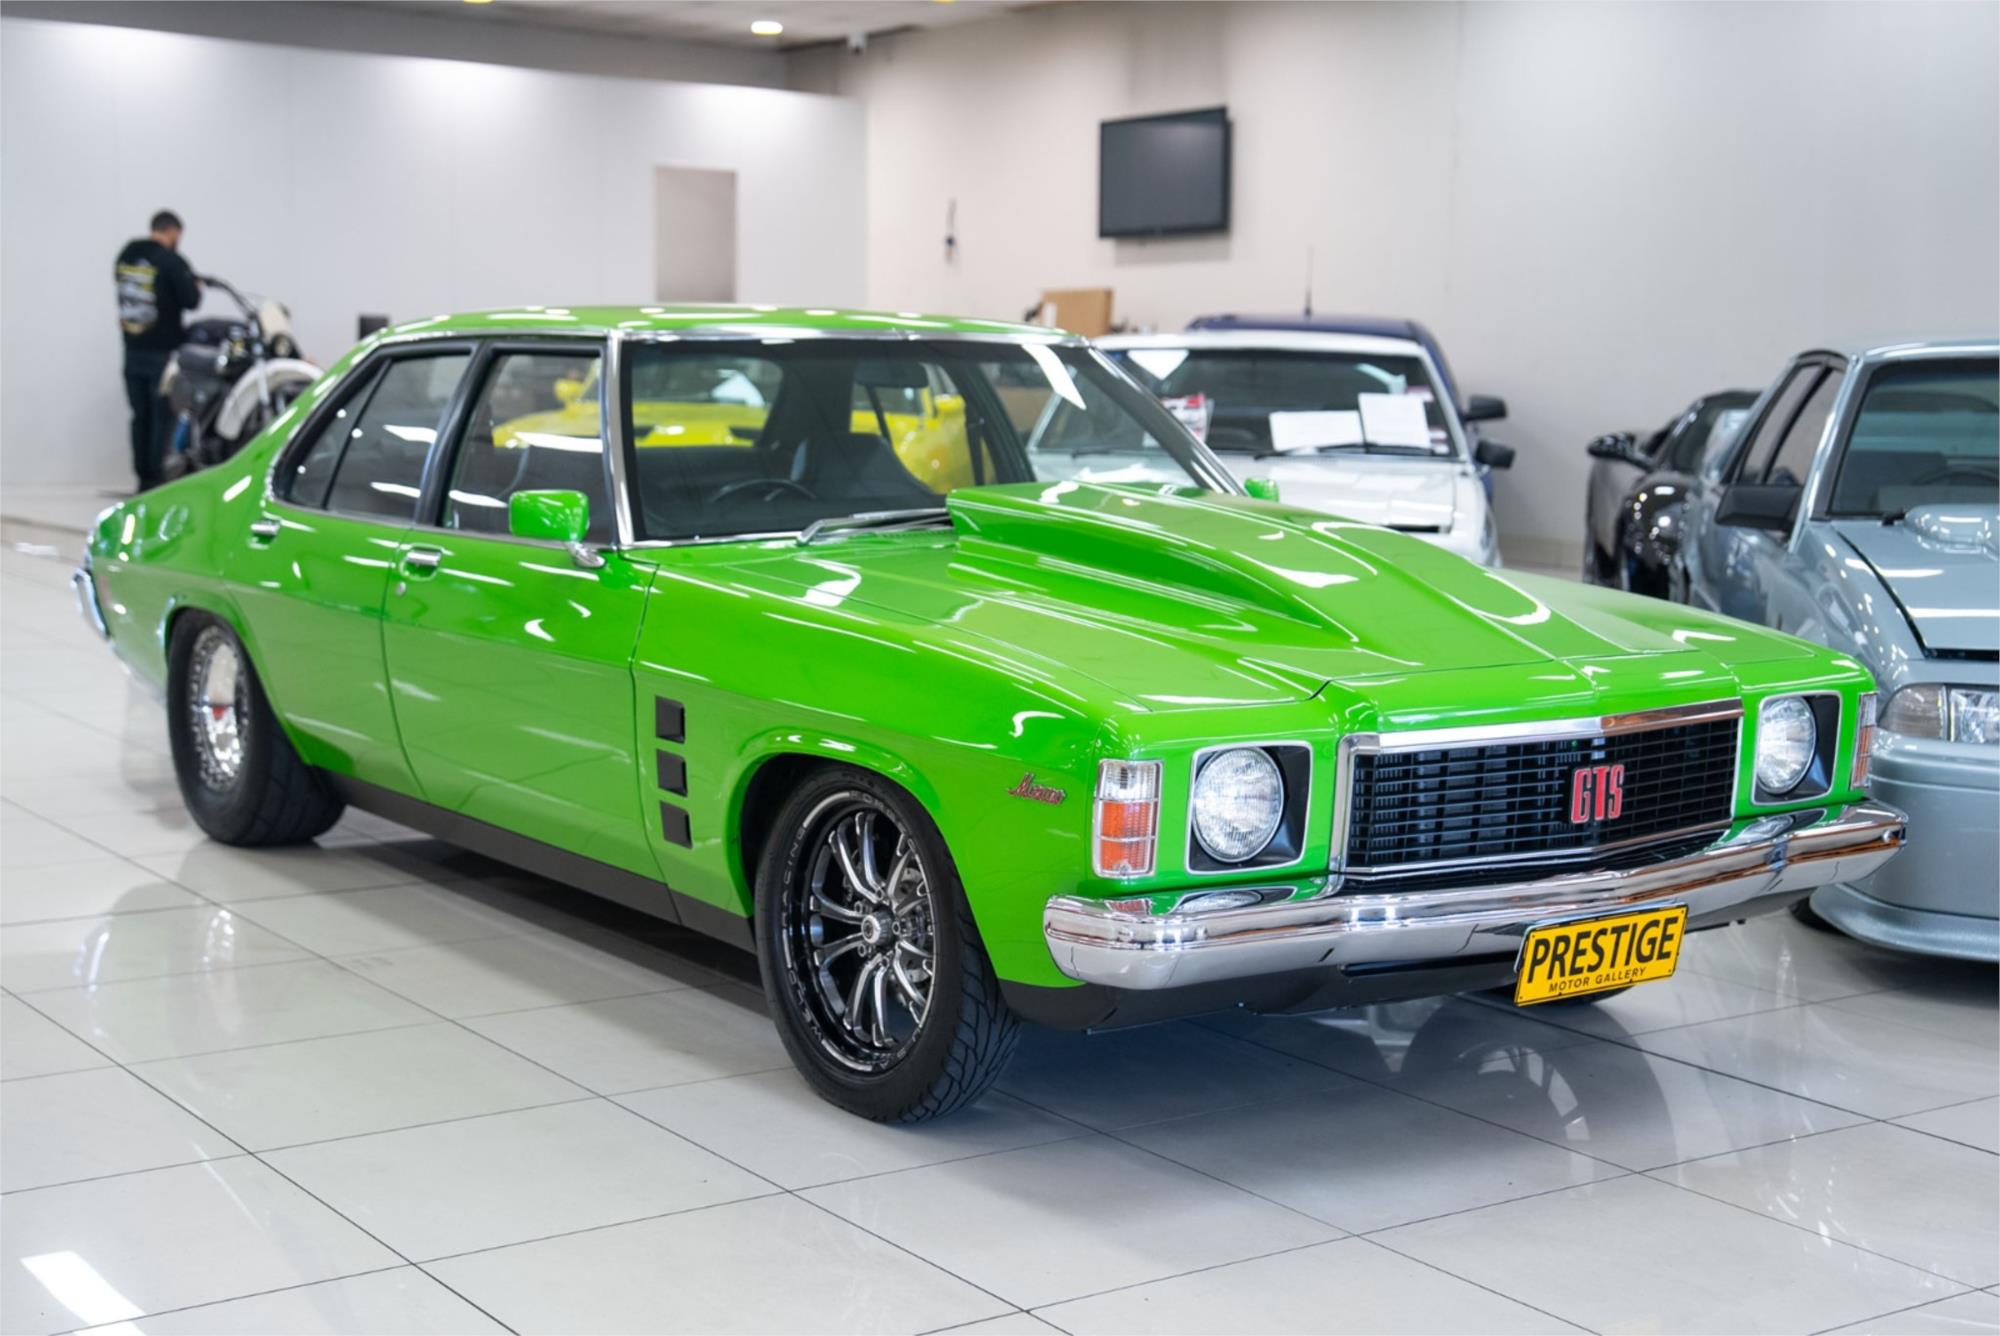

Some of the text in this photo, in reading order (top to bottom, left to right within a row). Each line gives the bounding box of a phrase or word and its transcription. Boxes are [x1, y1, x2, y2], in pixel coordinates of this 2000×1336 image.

[1571, 764, 1625, 824] GTS
[1527, 916, 1679, 984] PRESTIGE
[1548, 966, 1648, 993] MOTOR GALLERY
